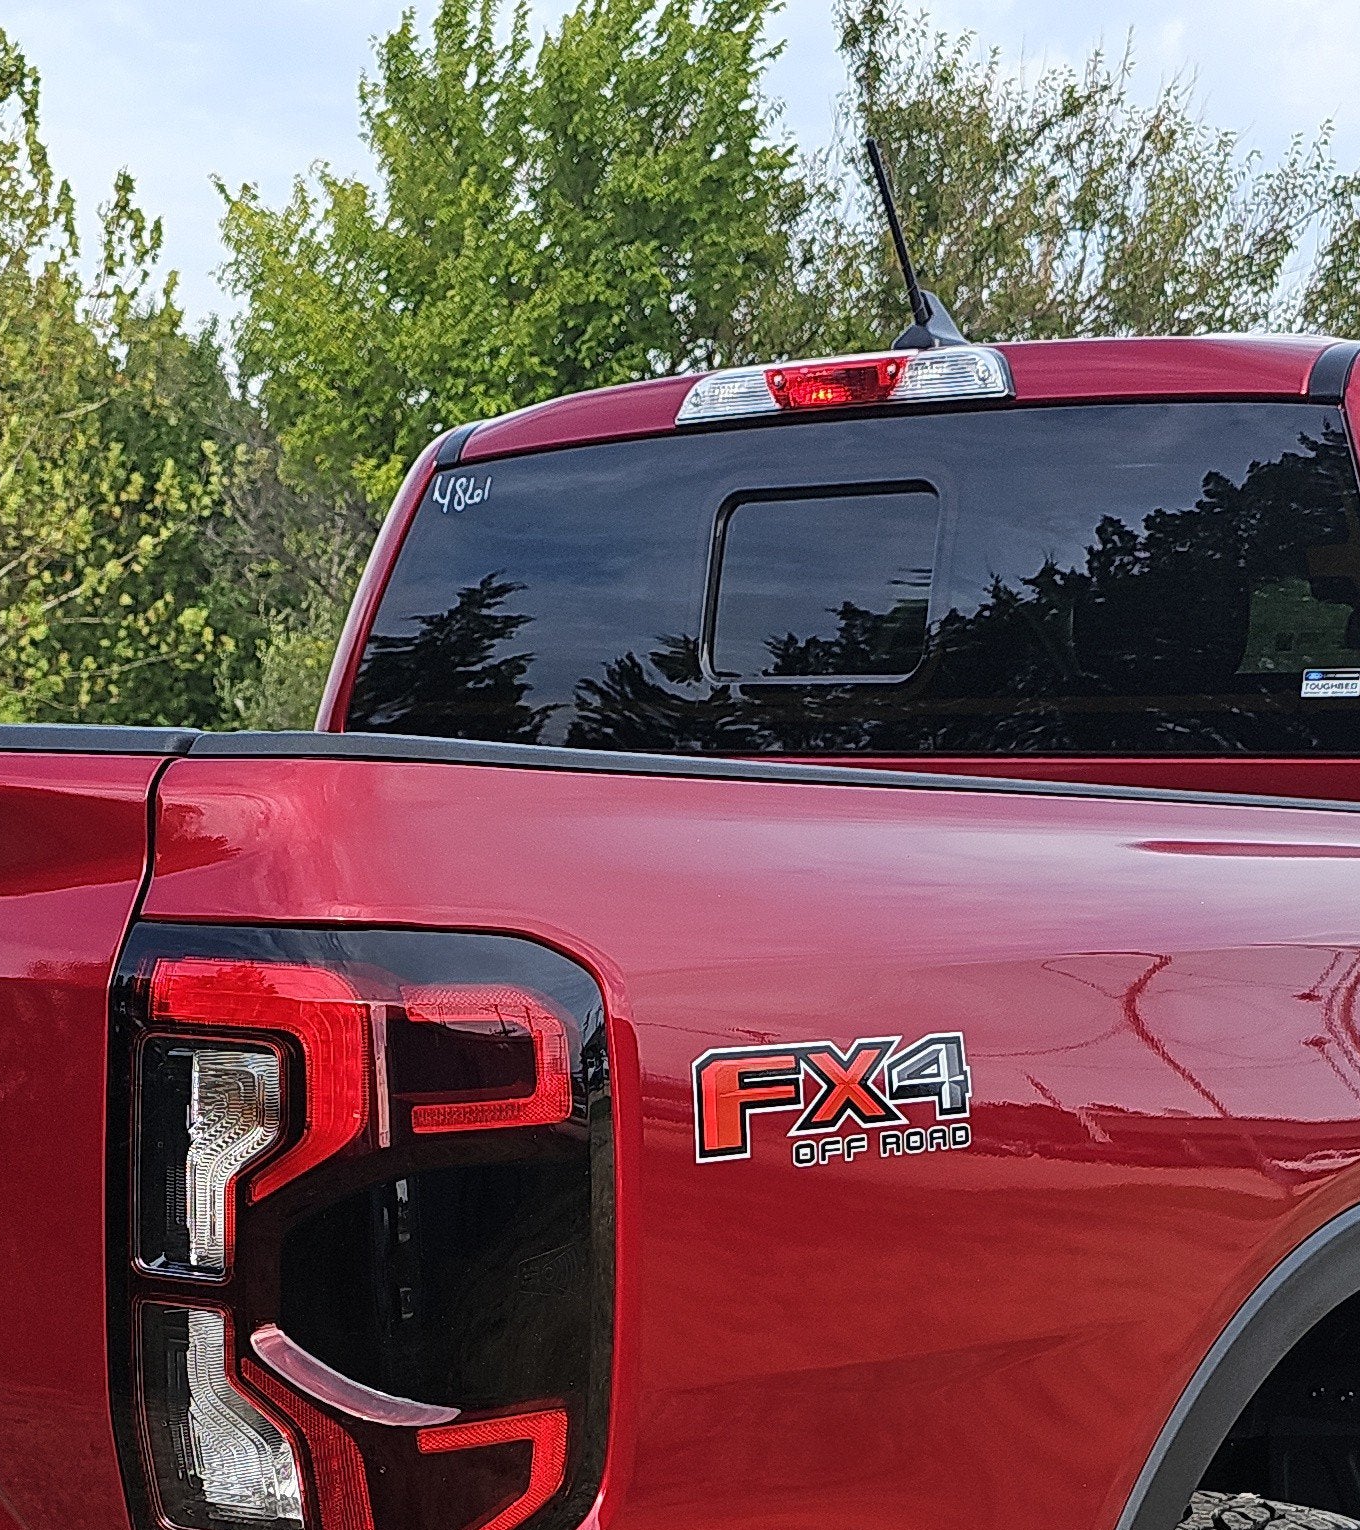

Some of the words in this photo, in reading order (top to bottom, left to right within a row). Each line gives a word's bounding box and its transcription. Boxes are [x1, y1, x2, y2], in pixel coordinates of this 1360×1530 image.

[432, 475, 493, 514] 4861
[691, 1031, 973, 1164] FX4
[792, 1134, 868, 1168] OFF
[880, 1123, 972, 1158] ROAD
